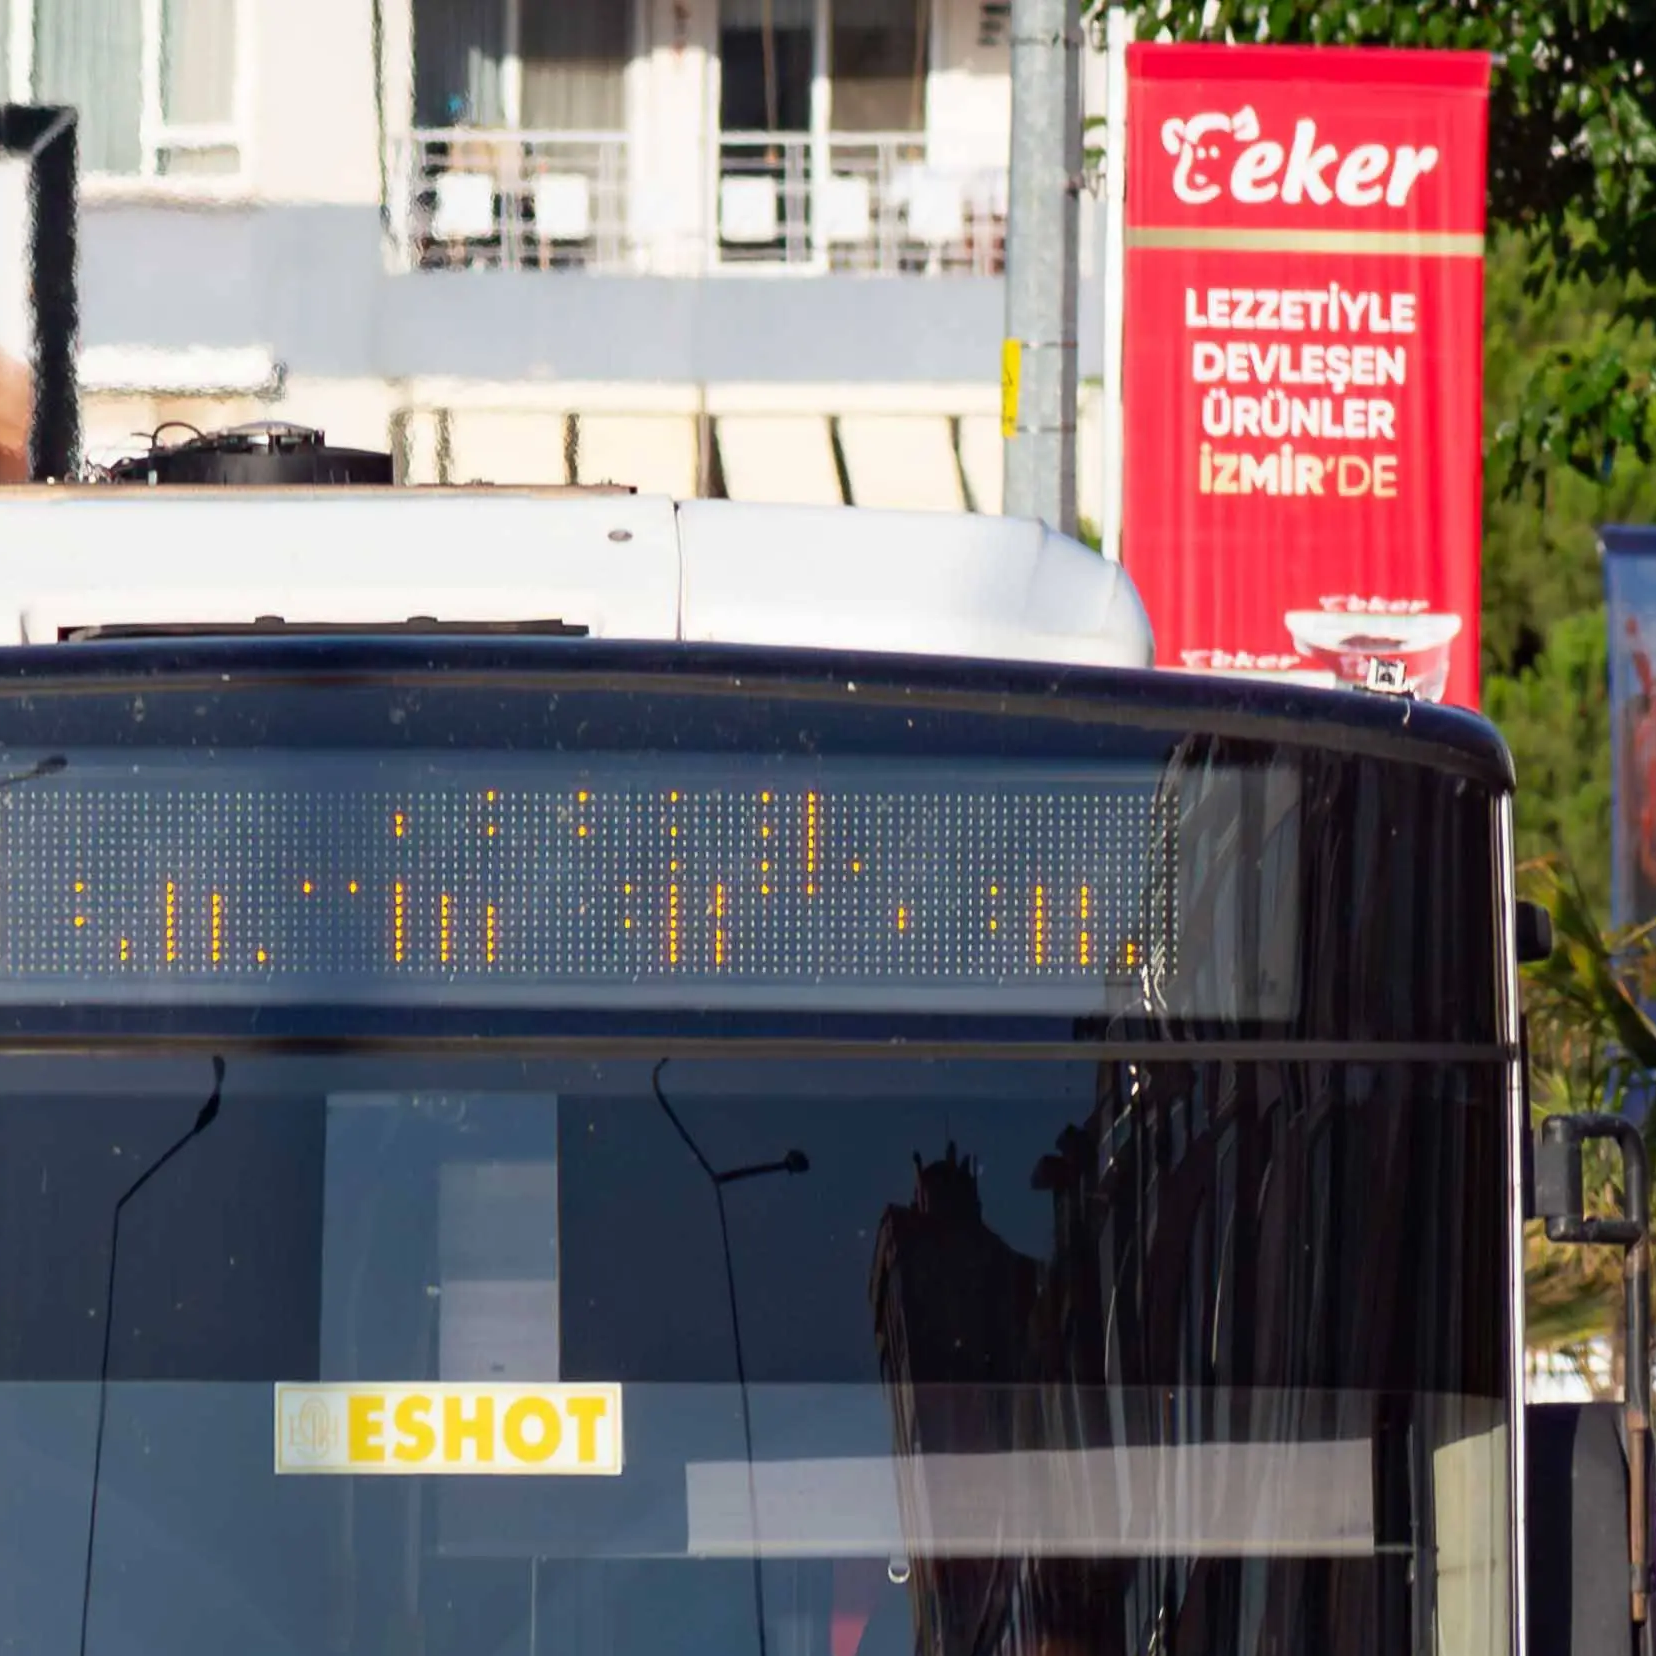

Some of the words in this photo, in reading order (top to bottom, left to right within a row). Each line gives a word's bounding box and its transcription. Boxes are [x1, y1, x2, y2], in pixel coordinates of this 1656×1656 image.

[1185, 282, 1416, 333] LEZZETİYLE
[1192, 341, 1406, 394] DEVLEŞEN
[1202, 389, 1395, 439] ÜRÜNLER
[1200, 442, 1398, 497] İZMİR'DE
[348, 1394, 607, 1464] ESHOT
